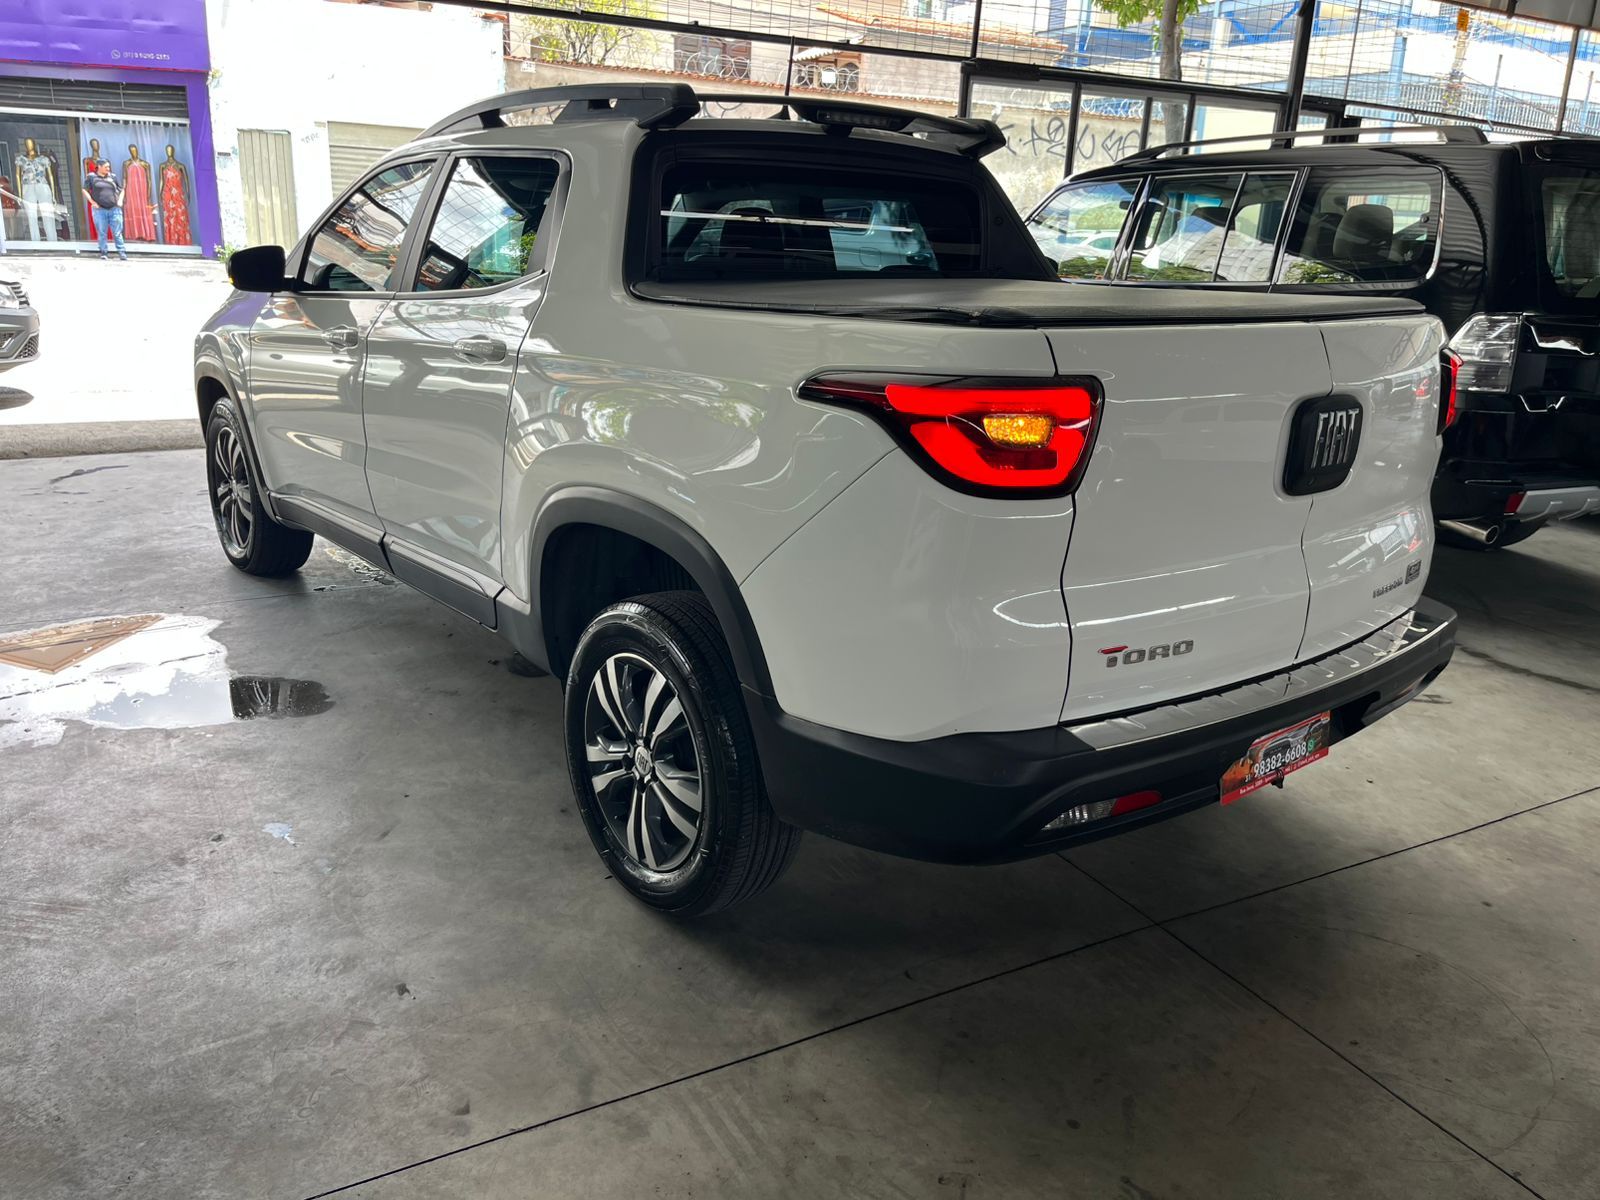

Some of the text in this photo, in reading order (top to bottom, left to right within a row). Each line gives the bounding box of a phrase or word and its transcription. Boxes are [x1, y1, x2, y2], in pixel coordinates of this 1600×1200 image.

[1310, 408, 1360, 469] FIAT
[1097, 639, 1194, 668] TORO
[1253, 742, 1307, 778] 98382-6608
